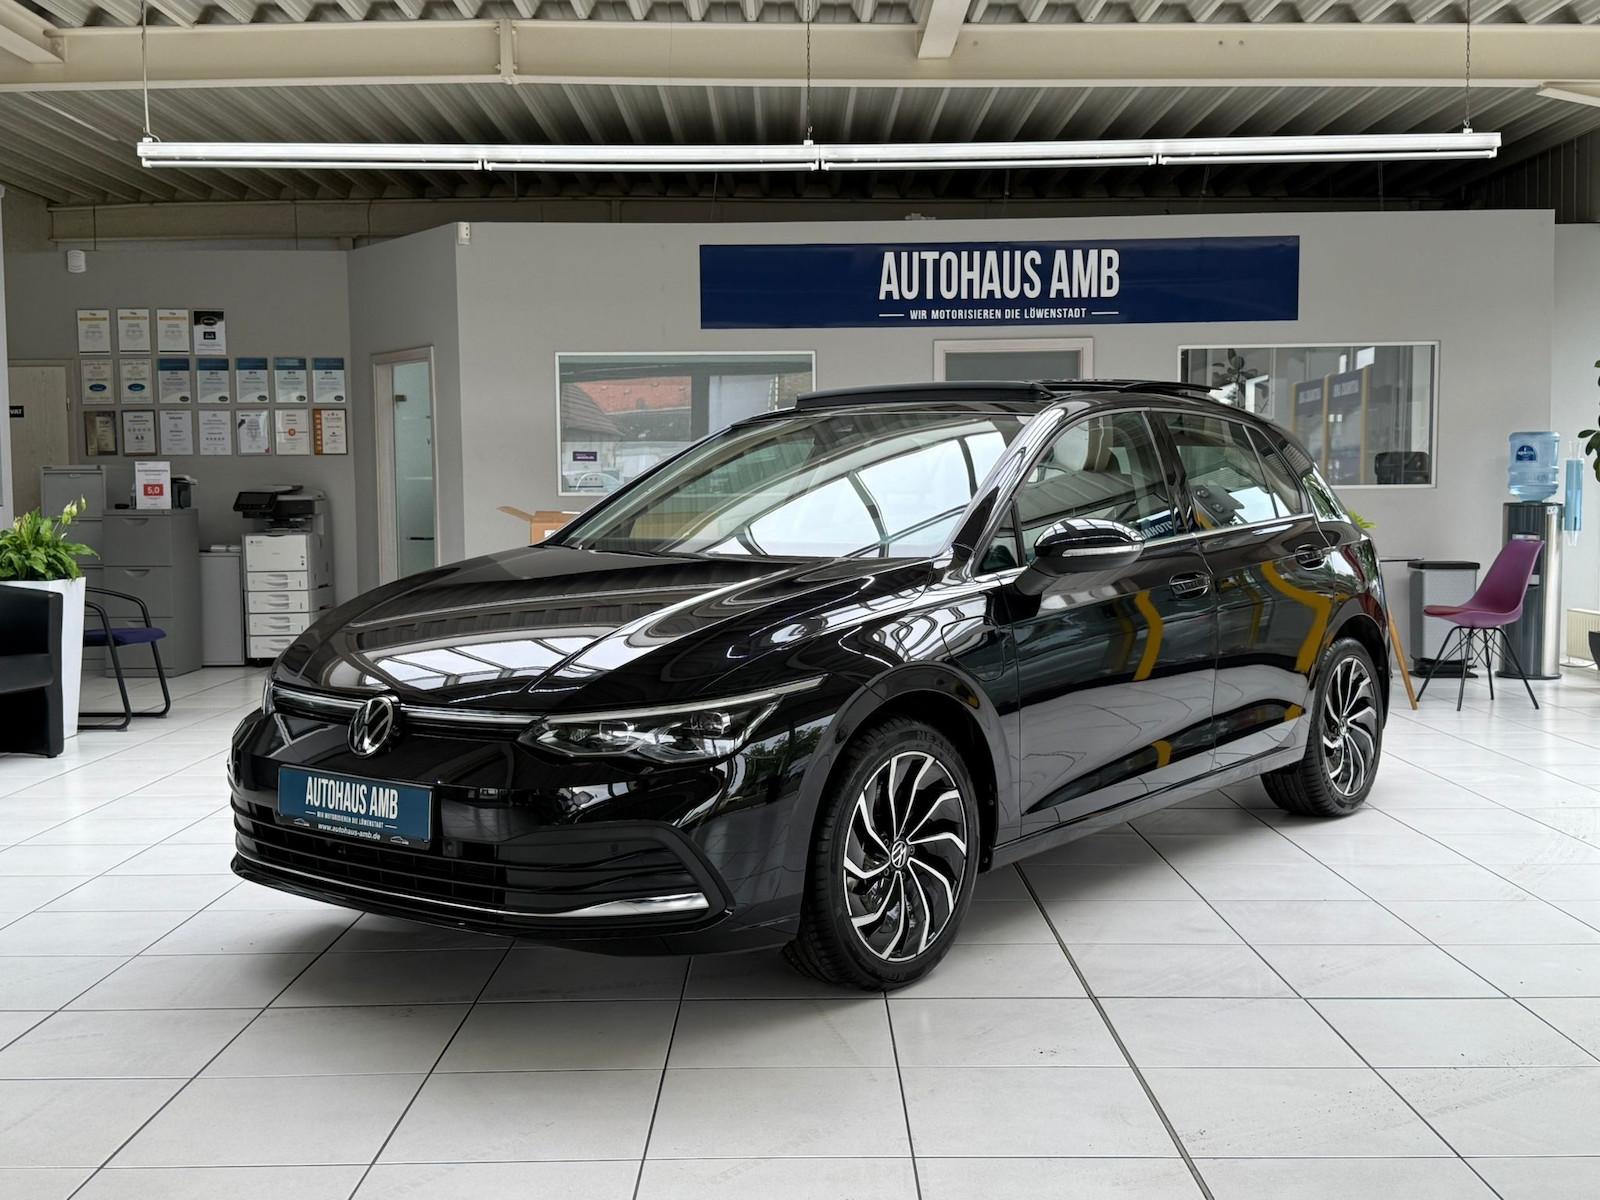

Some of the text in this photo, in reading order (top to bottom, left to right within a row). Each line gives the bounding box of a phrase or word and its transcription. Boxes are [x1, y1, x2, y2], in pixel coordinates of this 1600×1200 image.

[879, 249, 1120, 300] AUTOHAUS AMB
[910, 307, 1087, 320] WIR MOTORISIEREN DIE LÖWENSTADT
[147, 486, 160, 495] 5,0
[305, 776, 398, 820] AUTOHAUS AMB
[317, 823, 381, 841] www.autohaus-amb.de
